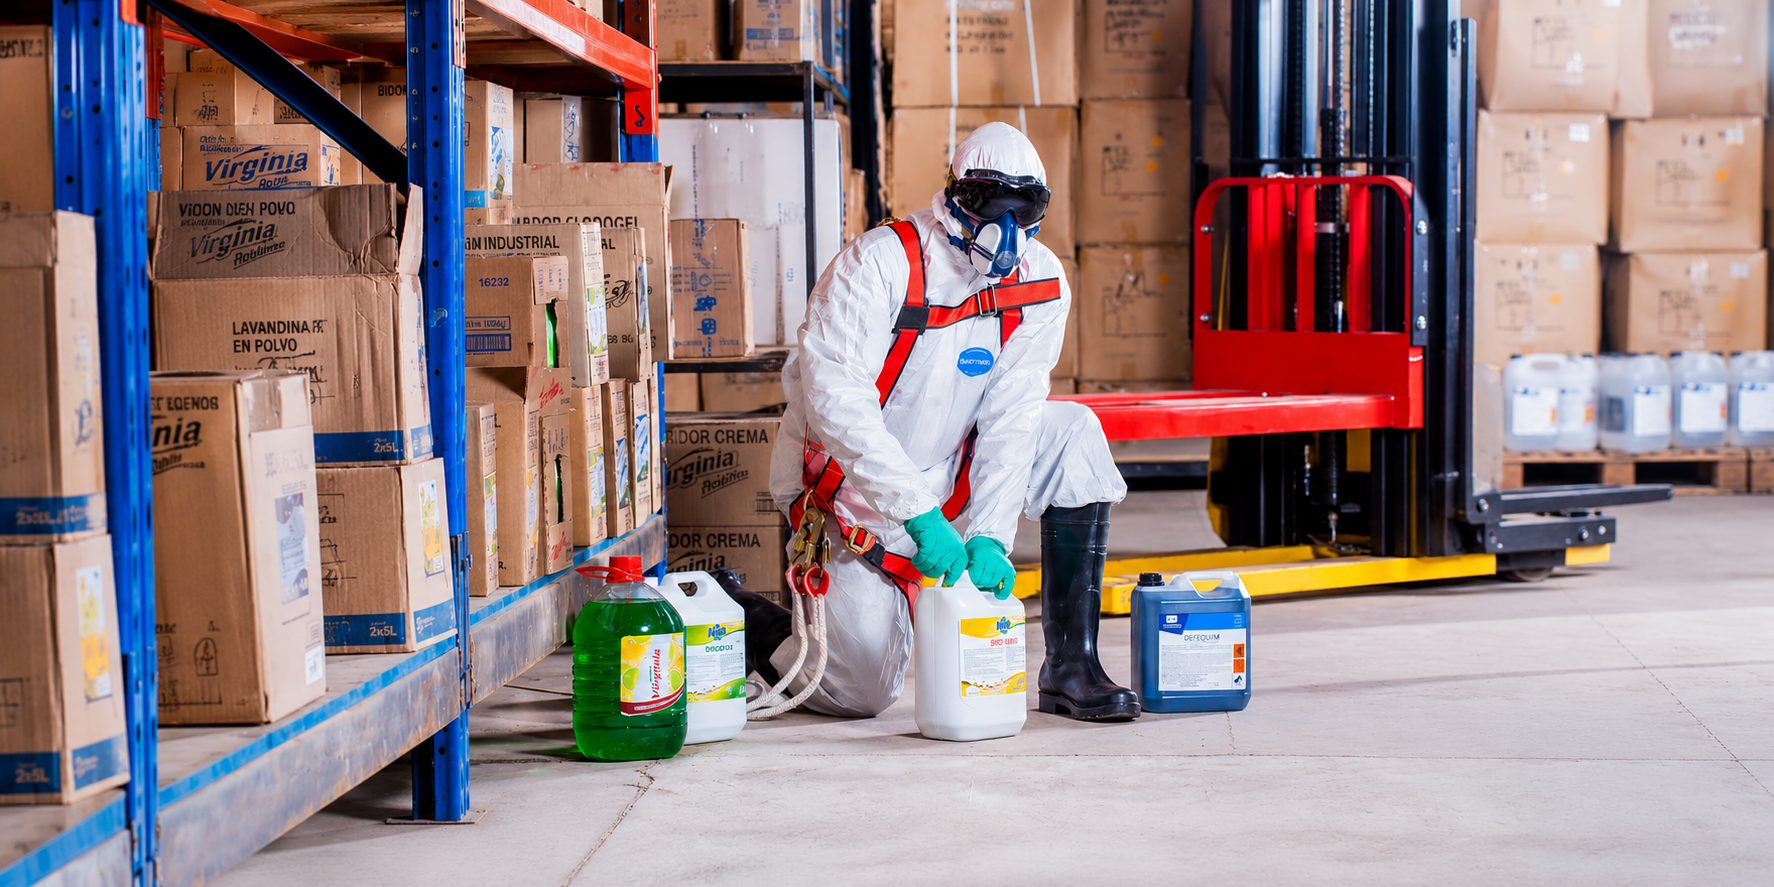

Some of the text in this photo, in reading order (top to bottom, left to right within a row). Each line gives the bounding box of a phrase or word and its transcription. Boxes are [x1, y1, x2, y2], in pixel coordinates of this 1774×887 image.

[206, 150, 308, 182] Virginia
[190, 221, 276, 258] Virginia
[484, 235, 560, 250] INDUSTRIAL
[479, 277, 509, 288] 16232
[232, 320, 311, 335] LAVANDINA
[233, 338, 298, 353] EN POLVO
[715, 429, 769, 444] CREMA
[667, 450, 734, 486] irginia
[669, 533, 761, 548] DOR CREMA
